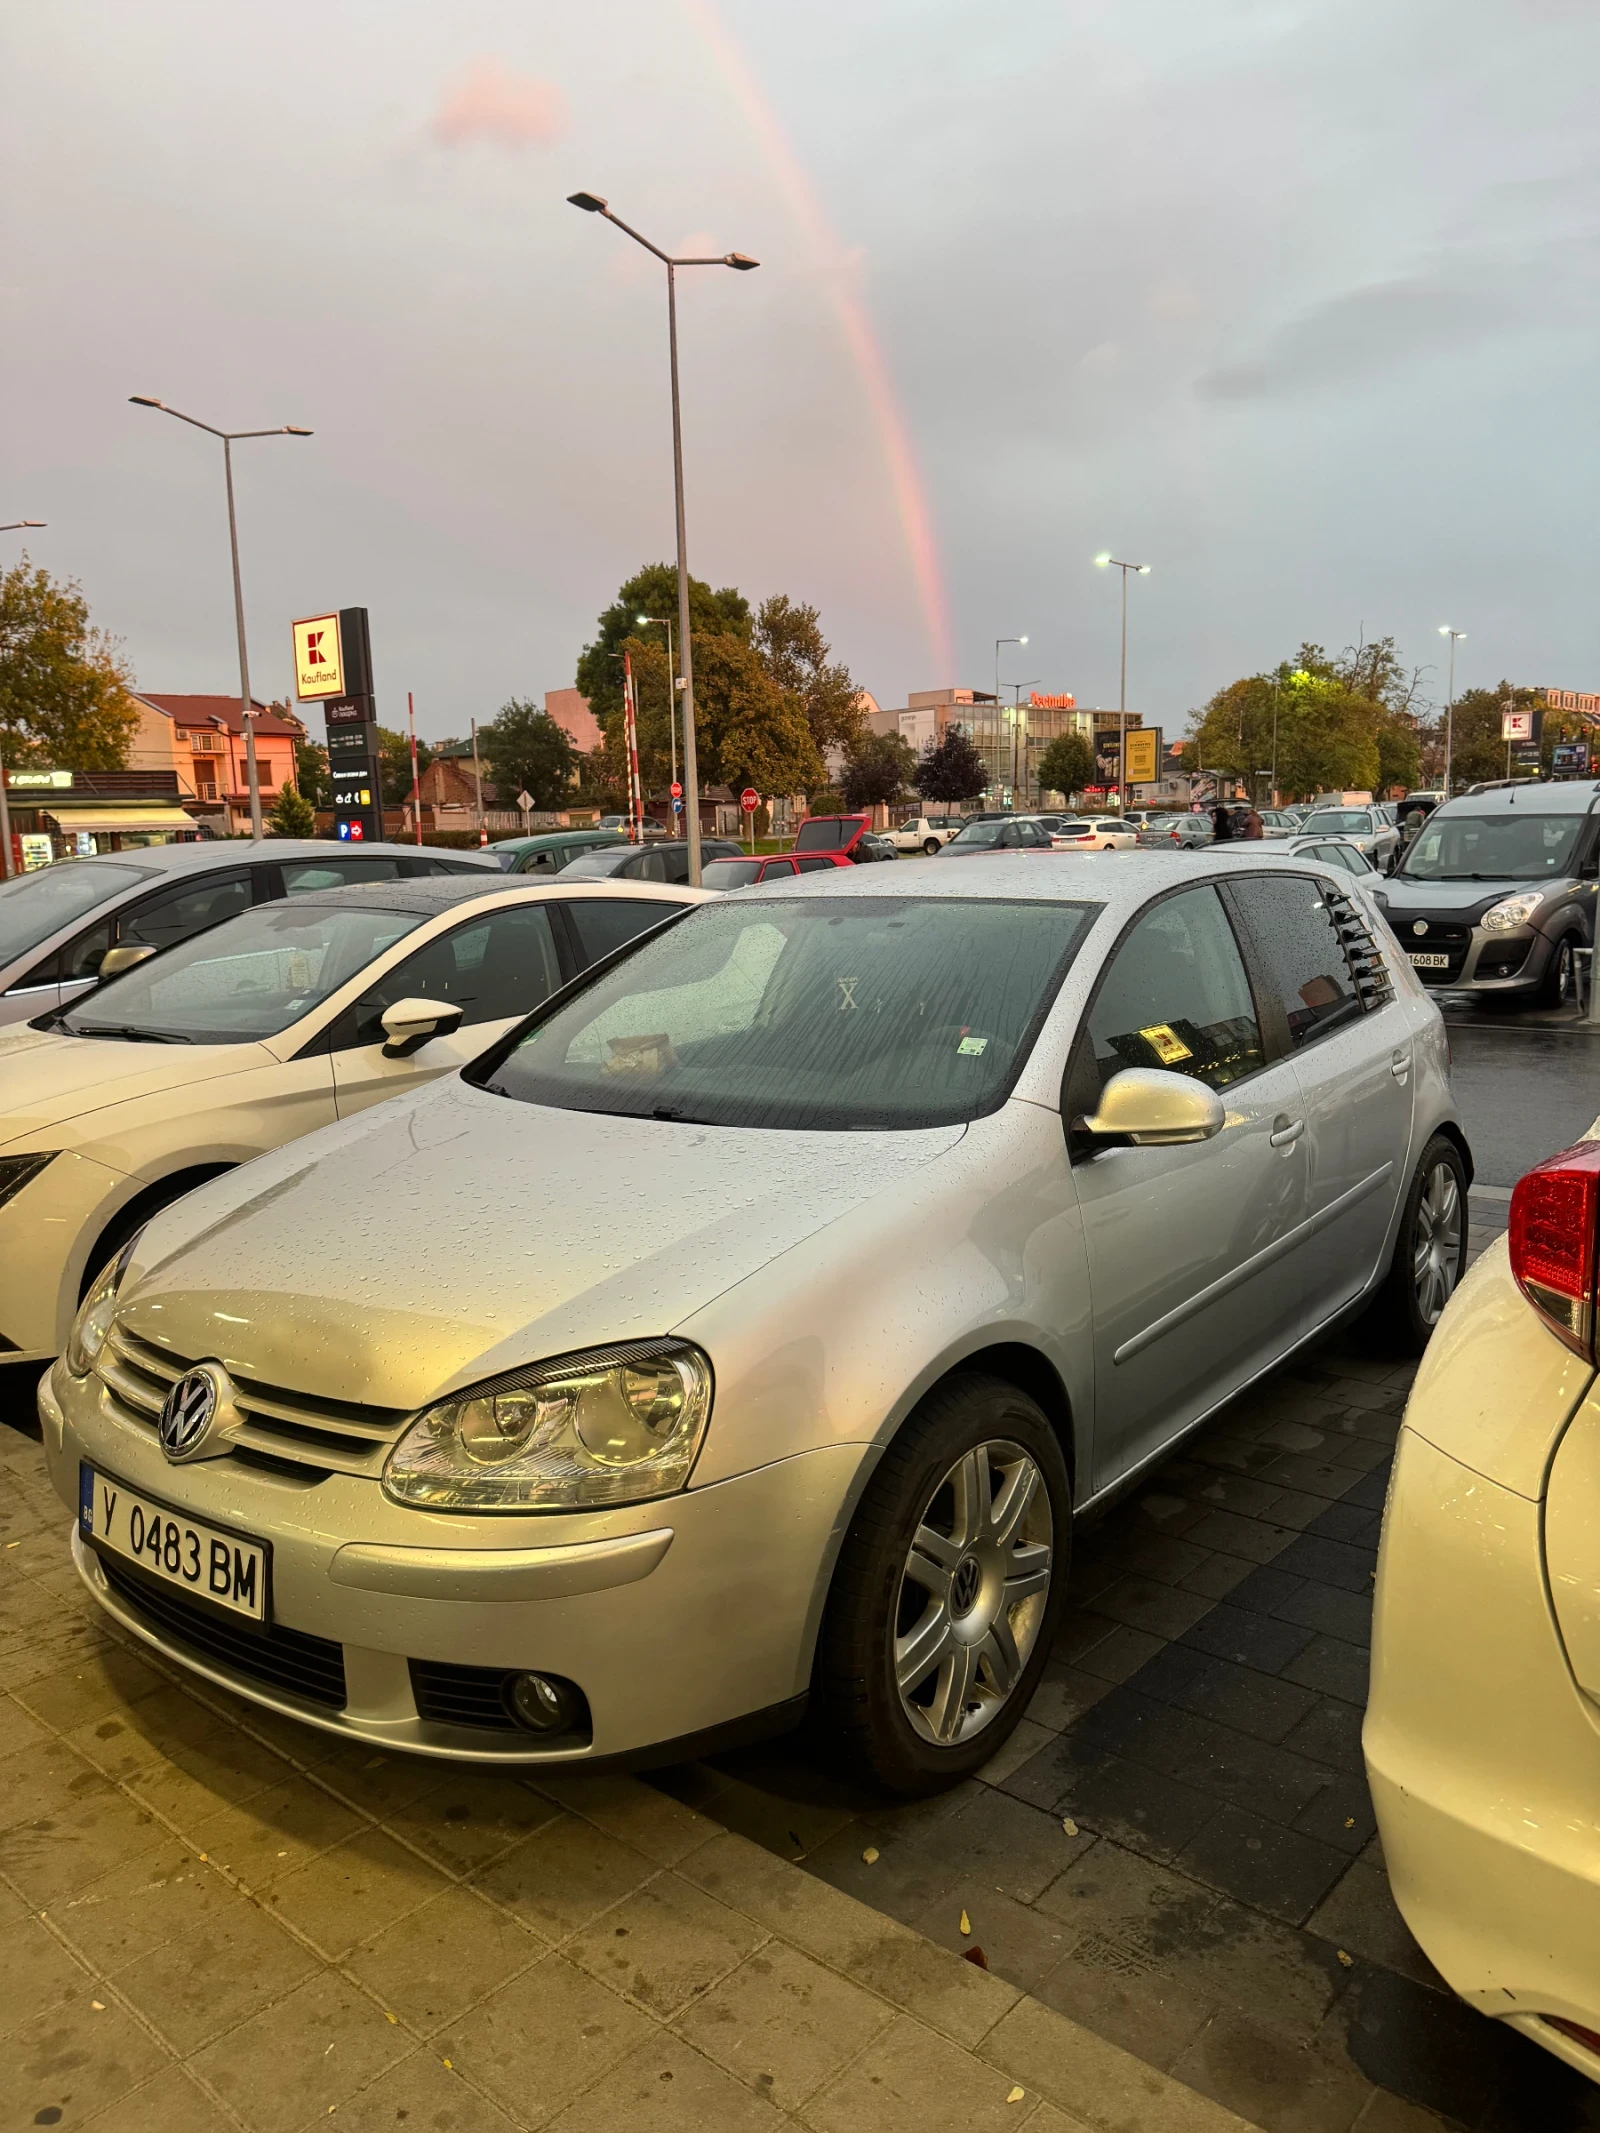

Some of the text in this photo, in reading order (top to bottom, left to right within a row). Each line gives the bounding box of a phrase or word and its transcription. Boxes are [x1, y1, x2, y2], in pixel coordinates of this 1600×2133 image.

[301, 668, 337, 685] Kaufland
[1030, 691, 1076, 709] Technika
[742, 796, 757, 805] STOP
[1409, 954, 1447, 966] 1608 BK
[83, 1504, 93, 1522] BG
[130, 1504, 201, 1582] 0483
[209, 1538, 256, 1609] BM
